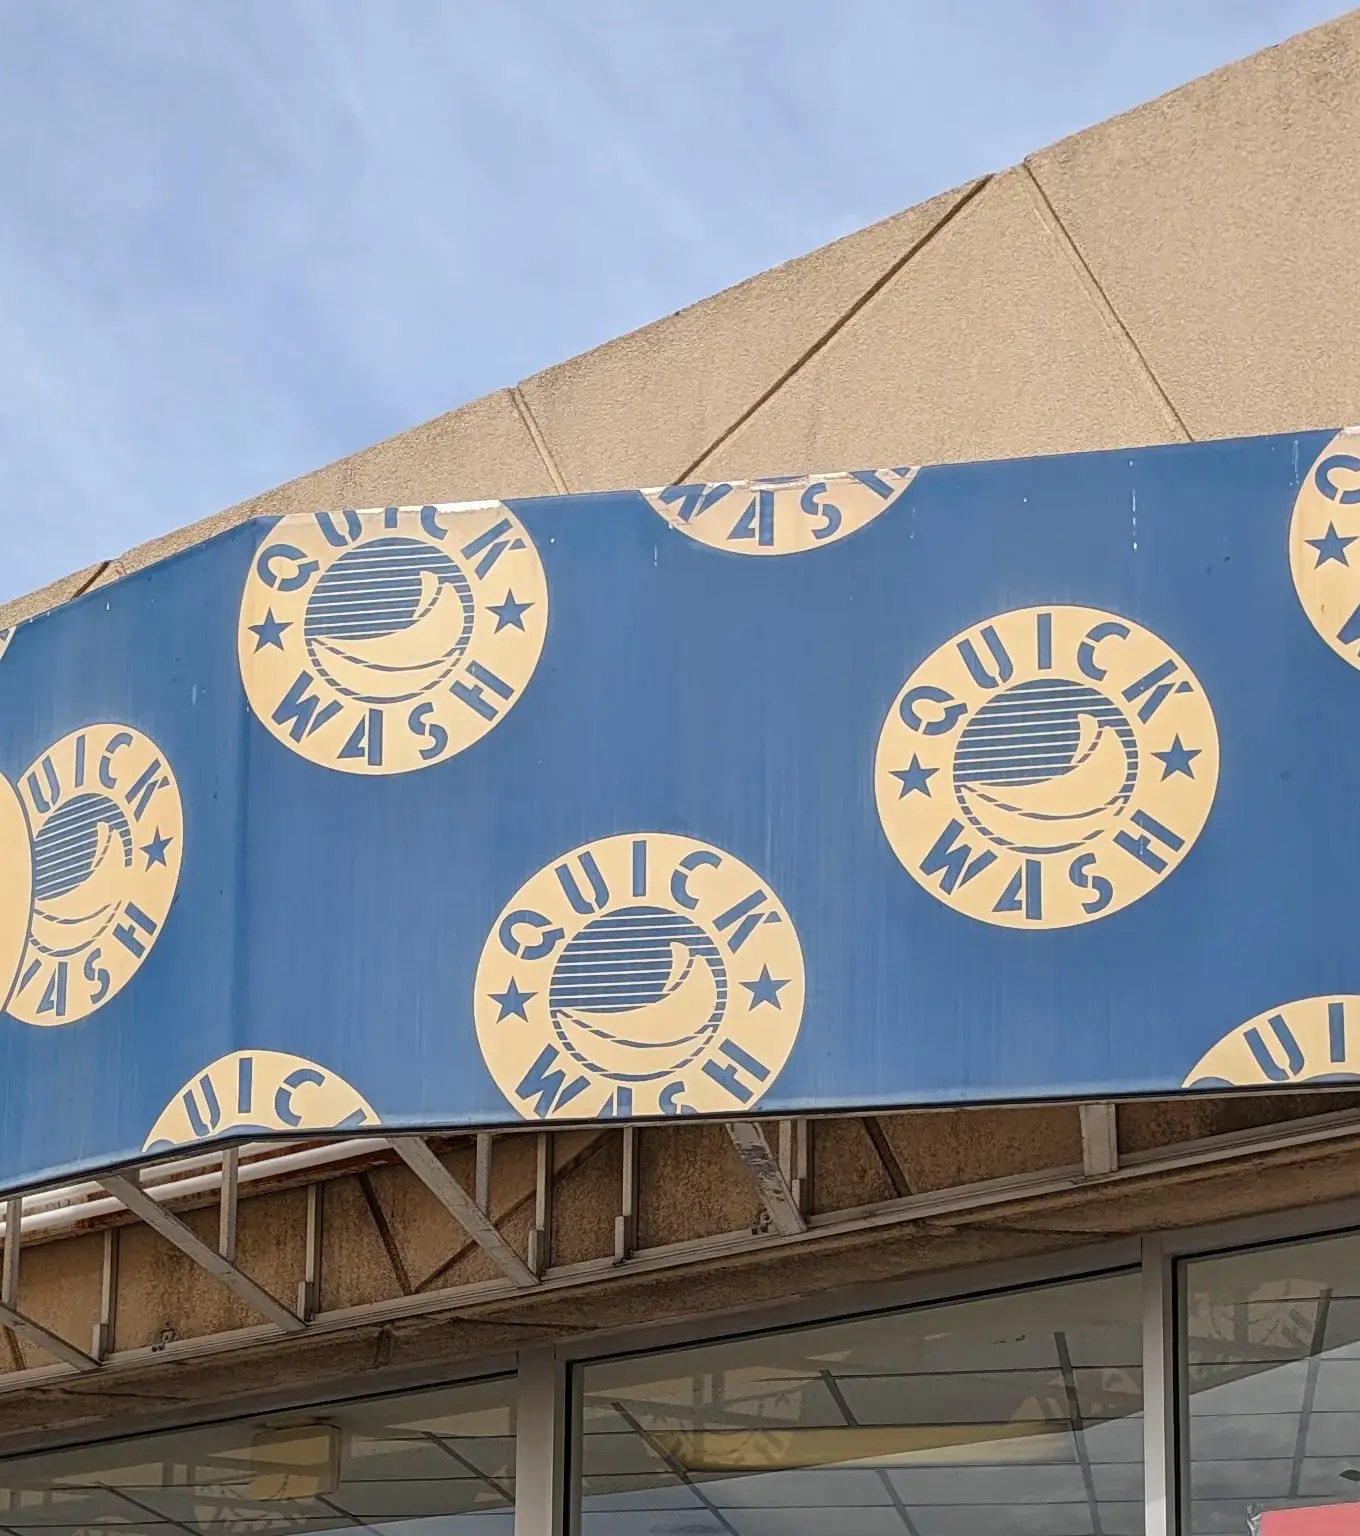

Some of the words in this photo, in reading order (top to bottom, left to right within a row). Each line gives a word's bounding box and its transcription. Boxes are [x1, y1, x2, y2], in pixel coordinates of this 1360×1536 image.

[272, 660, 515, 766] WASH
[899, 613, 1194, 737] QUICK
[27, 731, 171, 823] UICK
[499, 840, 782, 961] QUICK
[919, 809, 1187, 920] WASH
[148, 1056, 369, 1147] UIC
